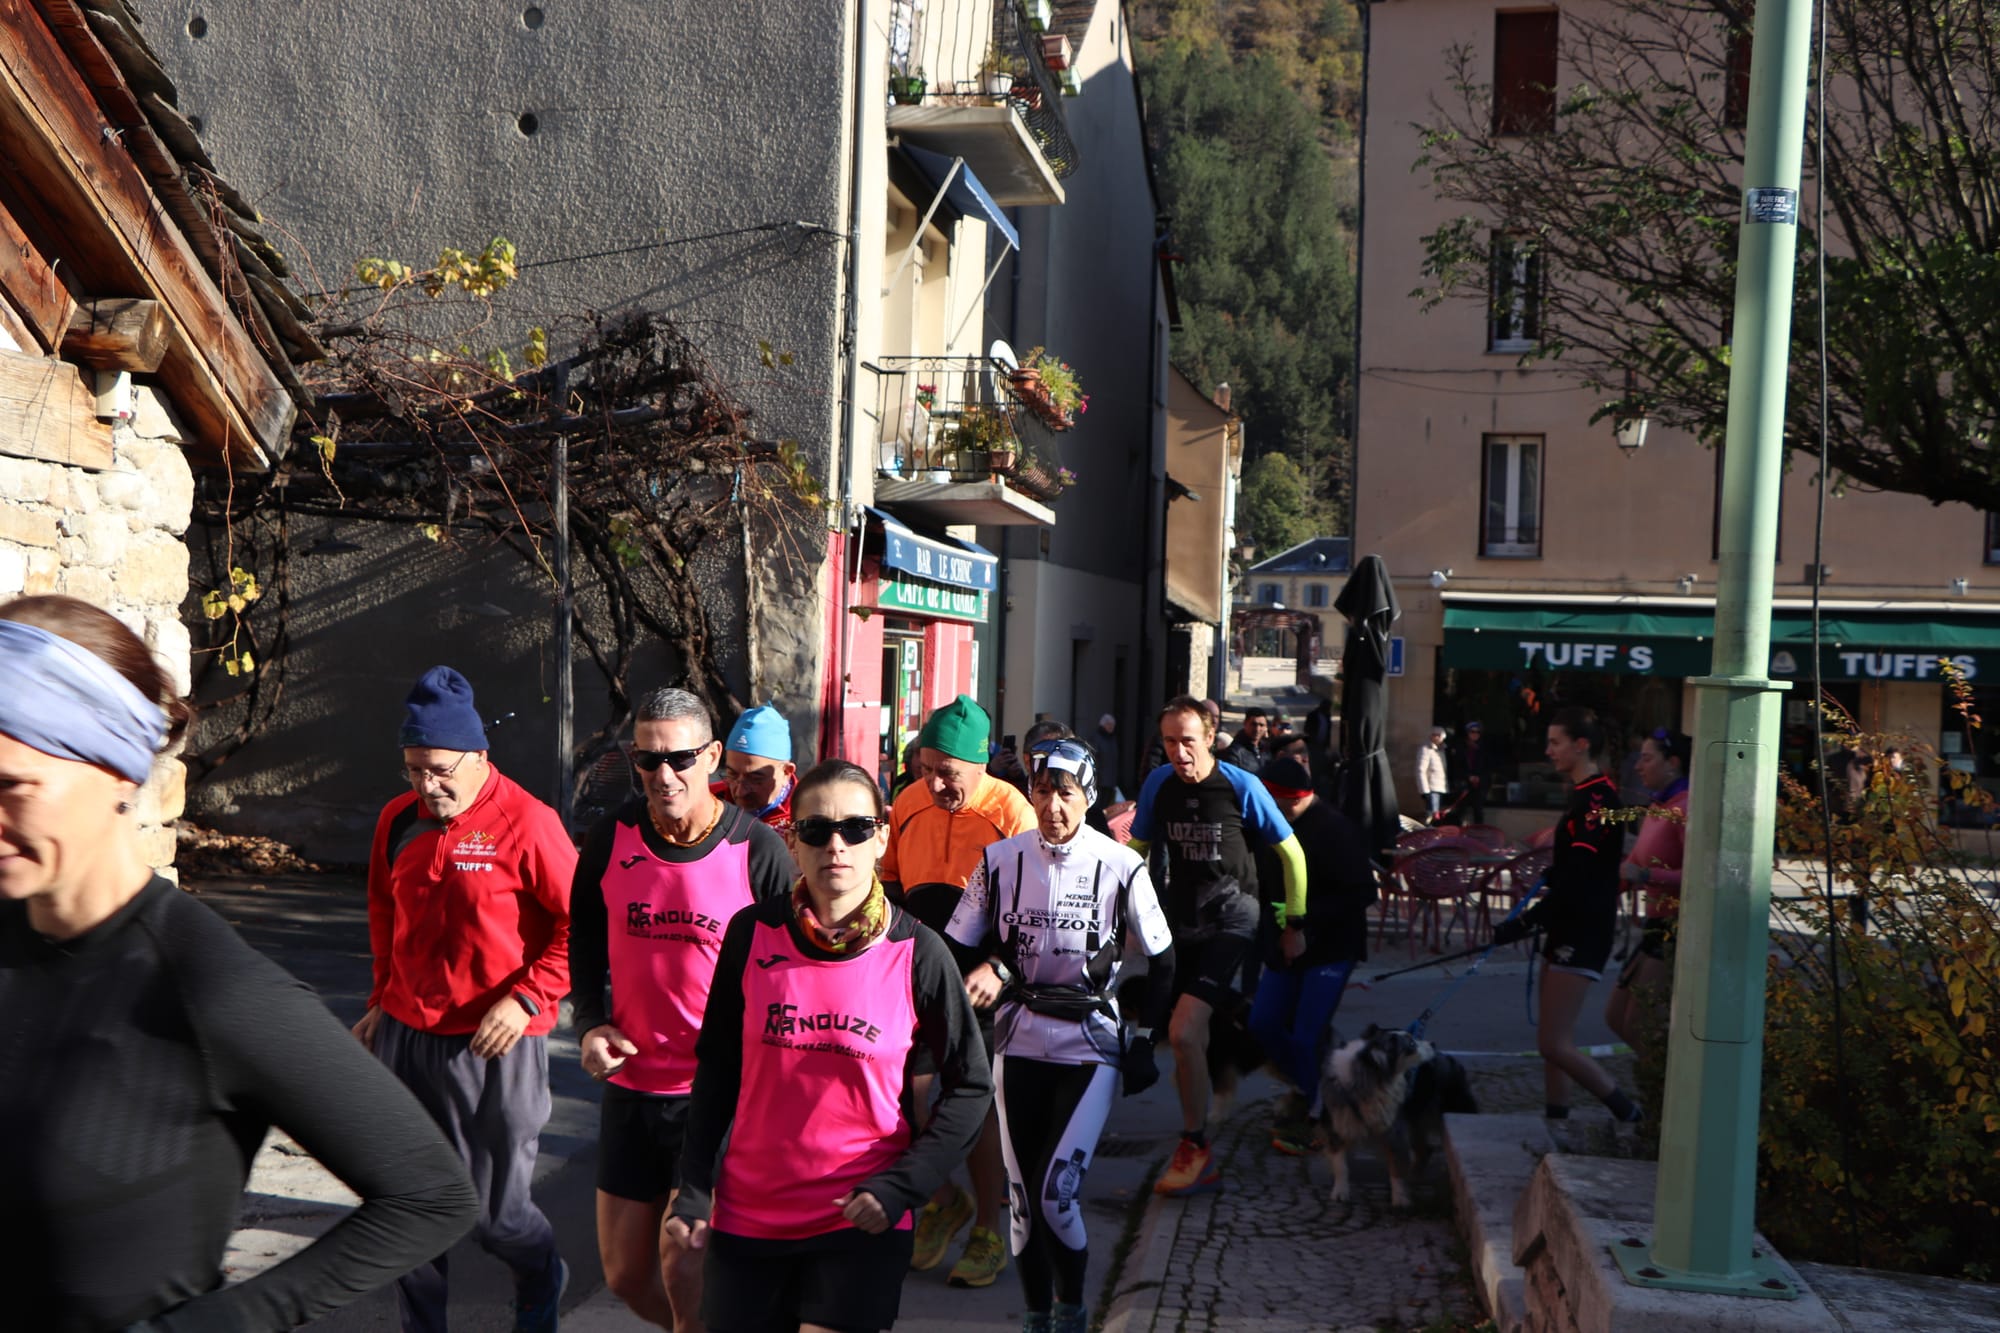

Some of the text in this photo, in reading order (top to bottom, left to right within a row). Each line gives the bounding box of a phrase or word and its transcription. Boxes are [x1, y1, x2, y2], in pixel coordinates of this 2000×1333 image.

[917, 547, 932, 575] BAR
[939, 554, 949, 580] LE
[1519, 641, 1653, 670] TUFF'S
[454, 861, 493, 872] TUFF'S
[1002, 912, 1100, 931] GLEYZON
